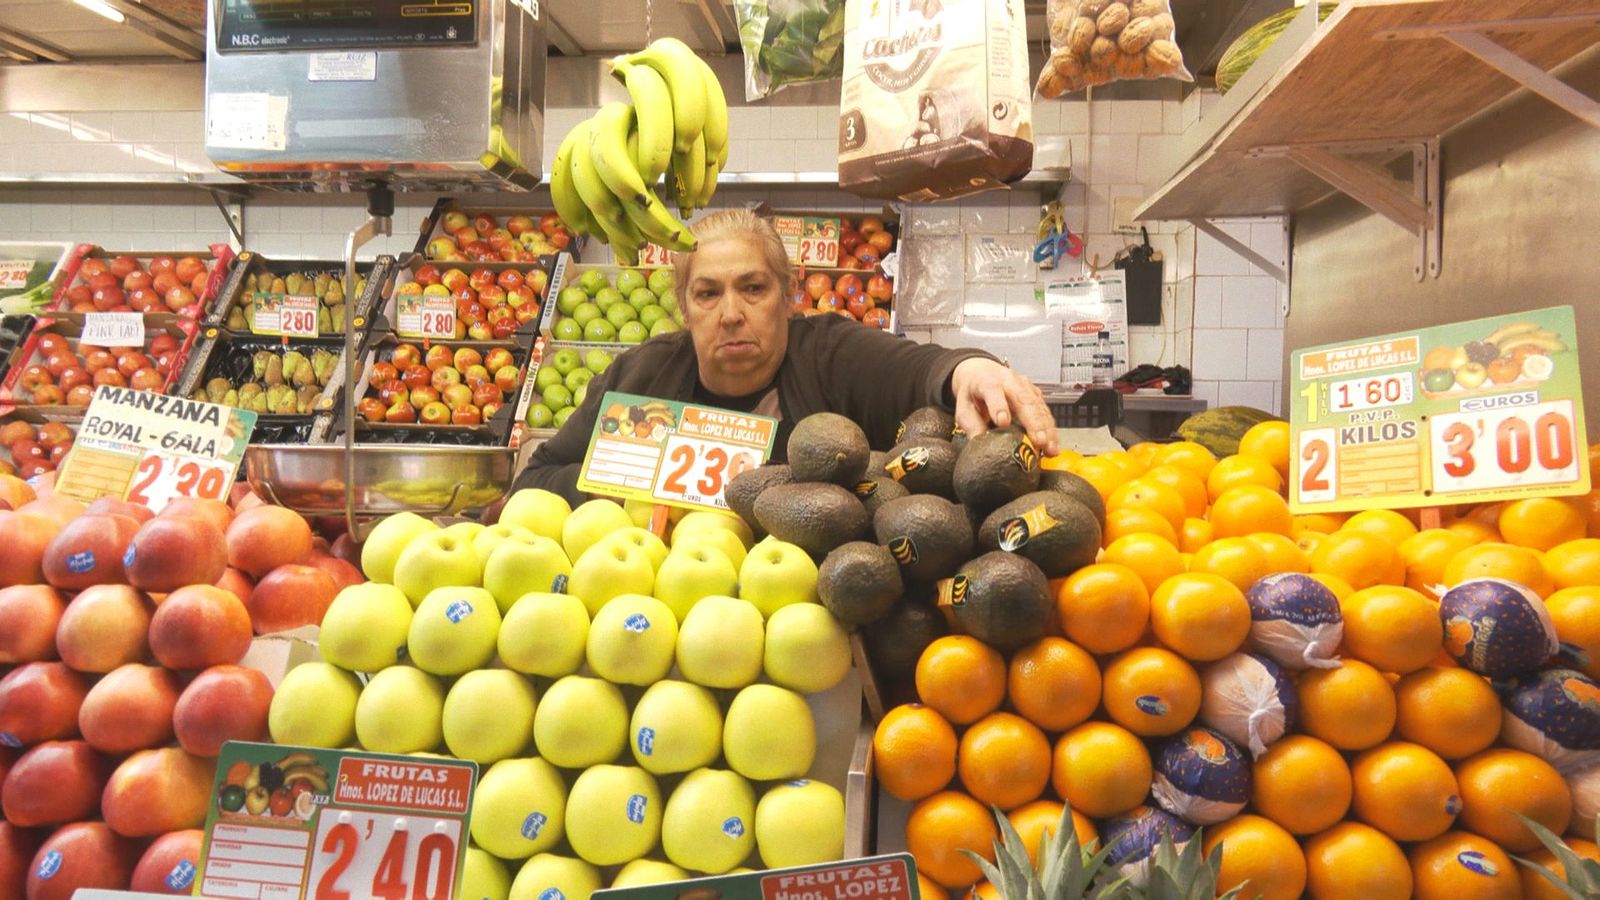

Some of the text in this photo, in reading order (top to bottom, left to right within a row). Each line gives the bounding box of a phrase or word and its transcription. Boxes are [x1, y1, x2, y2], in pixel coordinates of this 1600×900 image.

[231, 34, 260, 46] N.B.C
[846, 116, 856, 141] 3
[1326, 342, 1393, 361] FRUTAS
[1327, 359, 1356, 372] LOPEZ
[1357, 356, 1369, 368] DE
[1370, 352, 1399, 366] LUCAS
[1300, 382, 1318, 422] 1
[1338, 377, 1401, 409] 1'60
[98, 386, 220, 427] MANZANA
[1350, 410, 1399, 423] P.V.P.
[85, 416, 144, 444] ROYAL
[698, 411, 758, 429] FRUTAS
[701, 423, 723, 436] LOPEZ
[723, 426, 734, 438] DE
[733, 428, 755, 441] LUCAS
[1341, 421, 1417, 445] KILOS
[1442, 412, 1573, 479] 3'00
[1302, 438, 1329, 492] 2
[362, 763, 449, 783] FRUTAS
[339, 783, 364, 800] Hnos.
[366, 782, 400, 802] LOPEZ
[400, 785, 415, 804] DE
[415, 786, 446, 807] LUCAS
[447, 789, 464, 809] S.L.
[316, 819, 456, 900] 2'40
[779, 863, 893, 889] FRUTAS
[834, 876, 902, 899] LOPEZ
